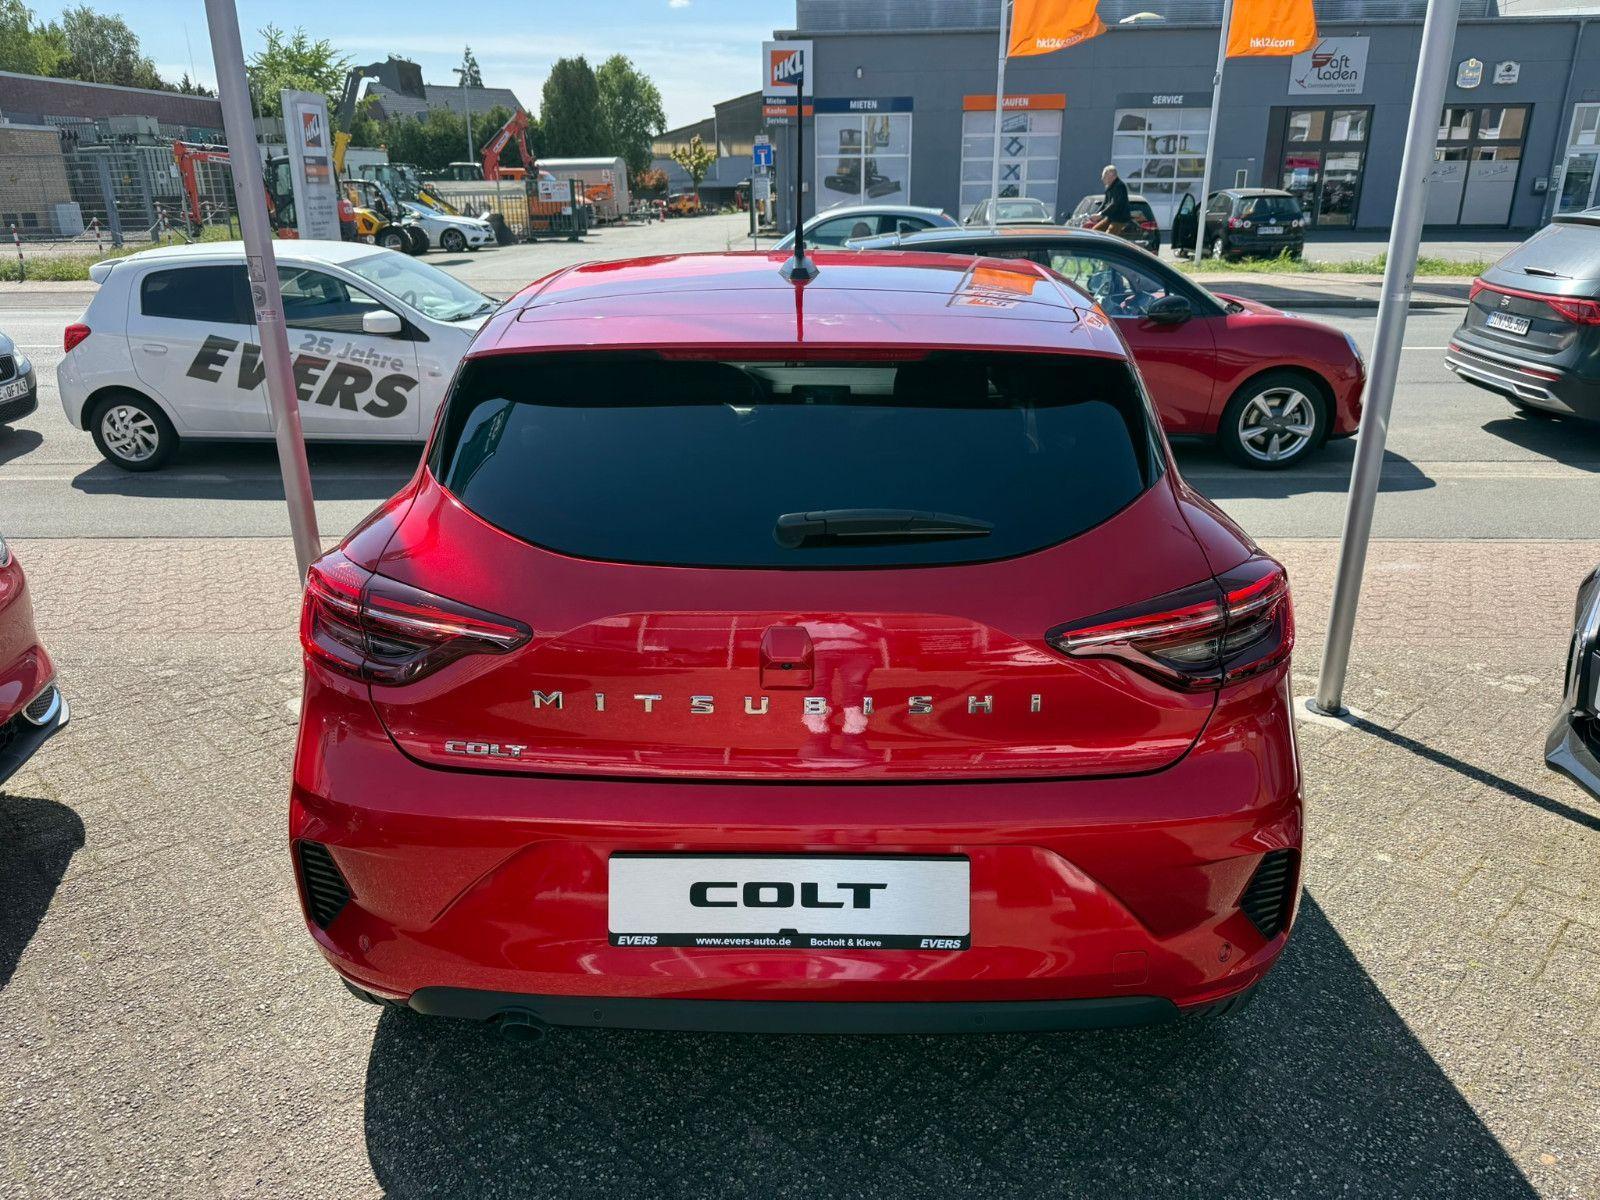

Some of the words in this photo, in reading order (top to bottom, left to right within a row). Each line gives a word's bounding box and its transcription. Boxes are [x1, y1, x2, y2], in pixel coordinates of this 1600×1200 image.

[773, 51, 804, 82] HKL
[766, 97, 788, 105] Mieten
[850, 100, 878, 109] MIETEN
[1152, 95, 1184, 105] SERVICE
[300, 333, 334, 354] 25
[337, 342, 404, 372] Jahre
[186, 334, 419, 419] EVERS
[531, 690, 1041, 715] MITSUBISHI
[445, 740, 528, 758] COLT
[690, 881, 888, 909] COLT
[617, 935, 658, 946] EVERS
[695, 937, 792, 947] www.evers-auto.de
[810, 938, 846, 947] Bocholt
[847, 939, 855, 947] &
[856, 939, 882, 948] Kleve
[920, 938, 962, 949] EVERS
